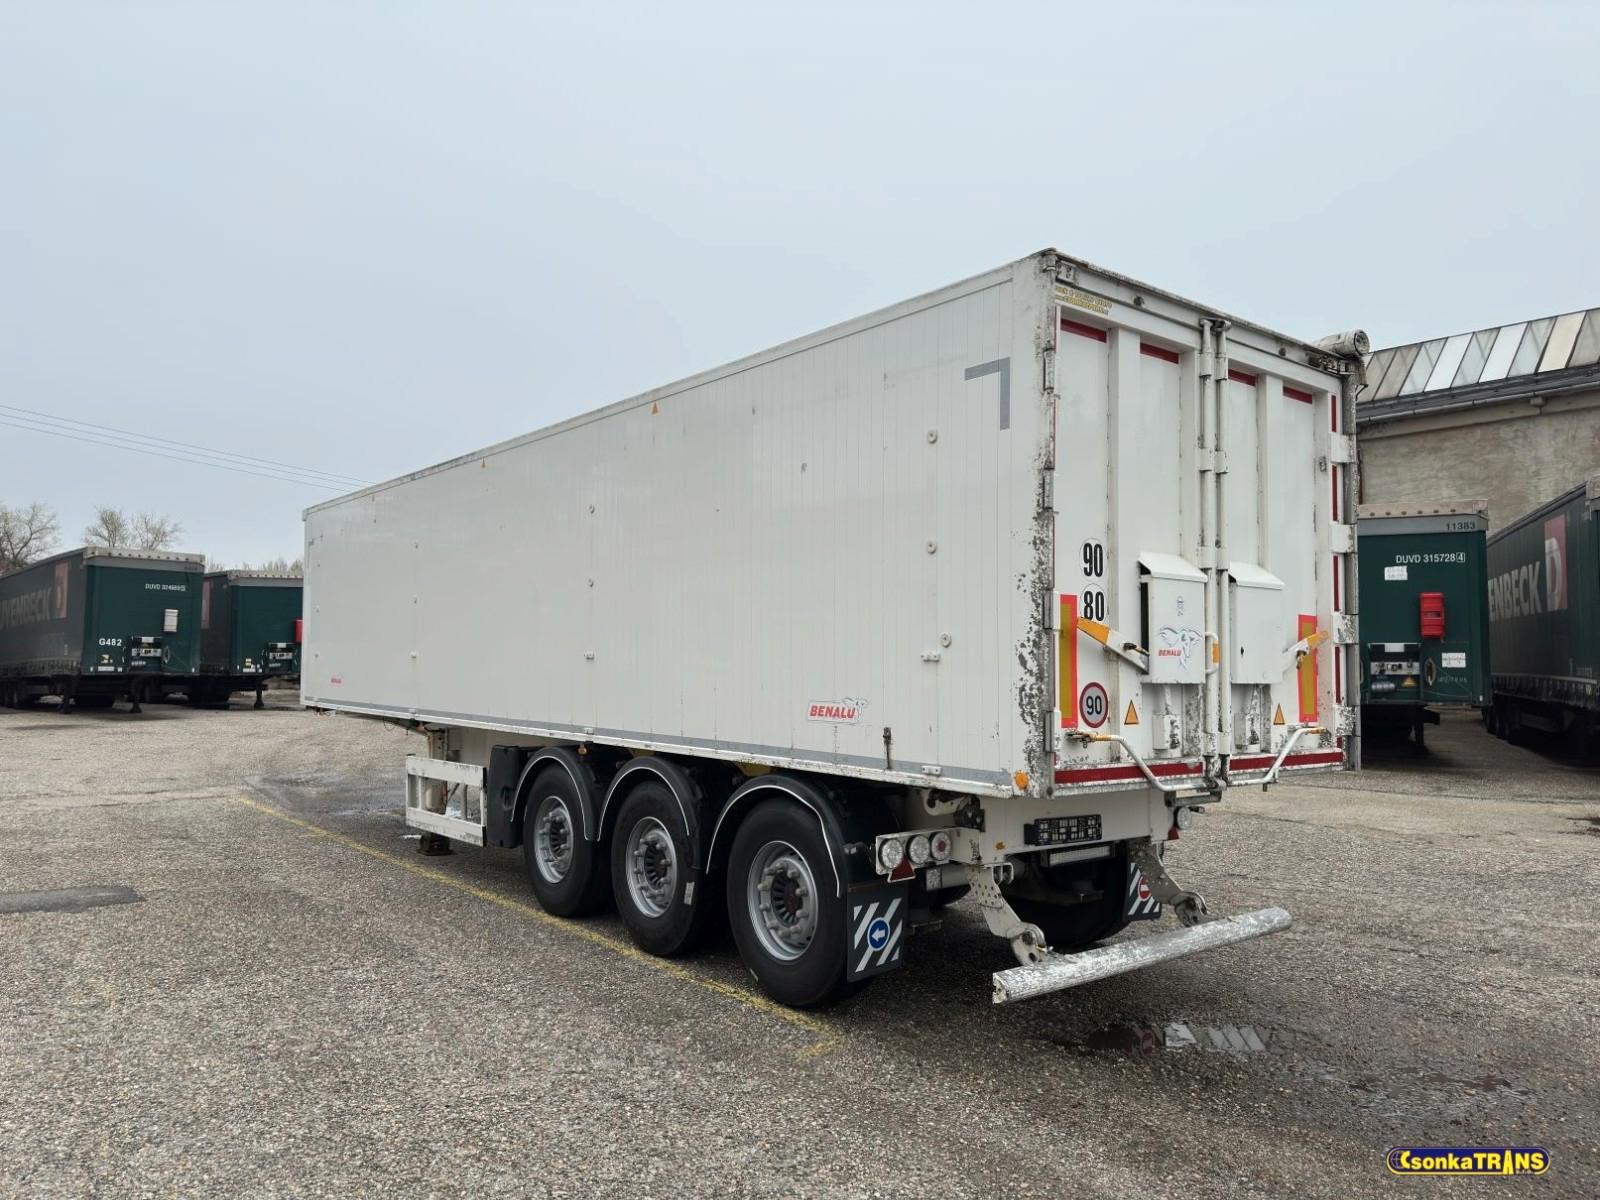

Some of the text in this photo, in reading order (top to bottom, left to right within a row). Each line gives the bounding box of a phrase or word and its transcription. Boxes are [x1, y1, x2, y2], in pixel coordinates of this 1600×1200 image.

[1083, 542, 1104, 577] 90
[1396, 554, 1421, 563] DUVD
[1083, 591, 1105, 621] 80
[98, 638, 122, 647] G482
[810, 705, 856, 719] BENALU
[1086, 695, 1103, 715] 90
